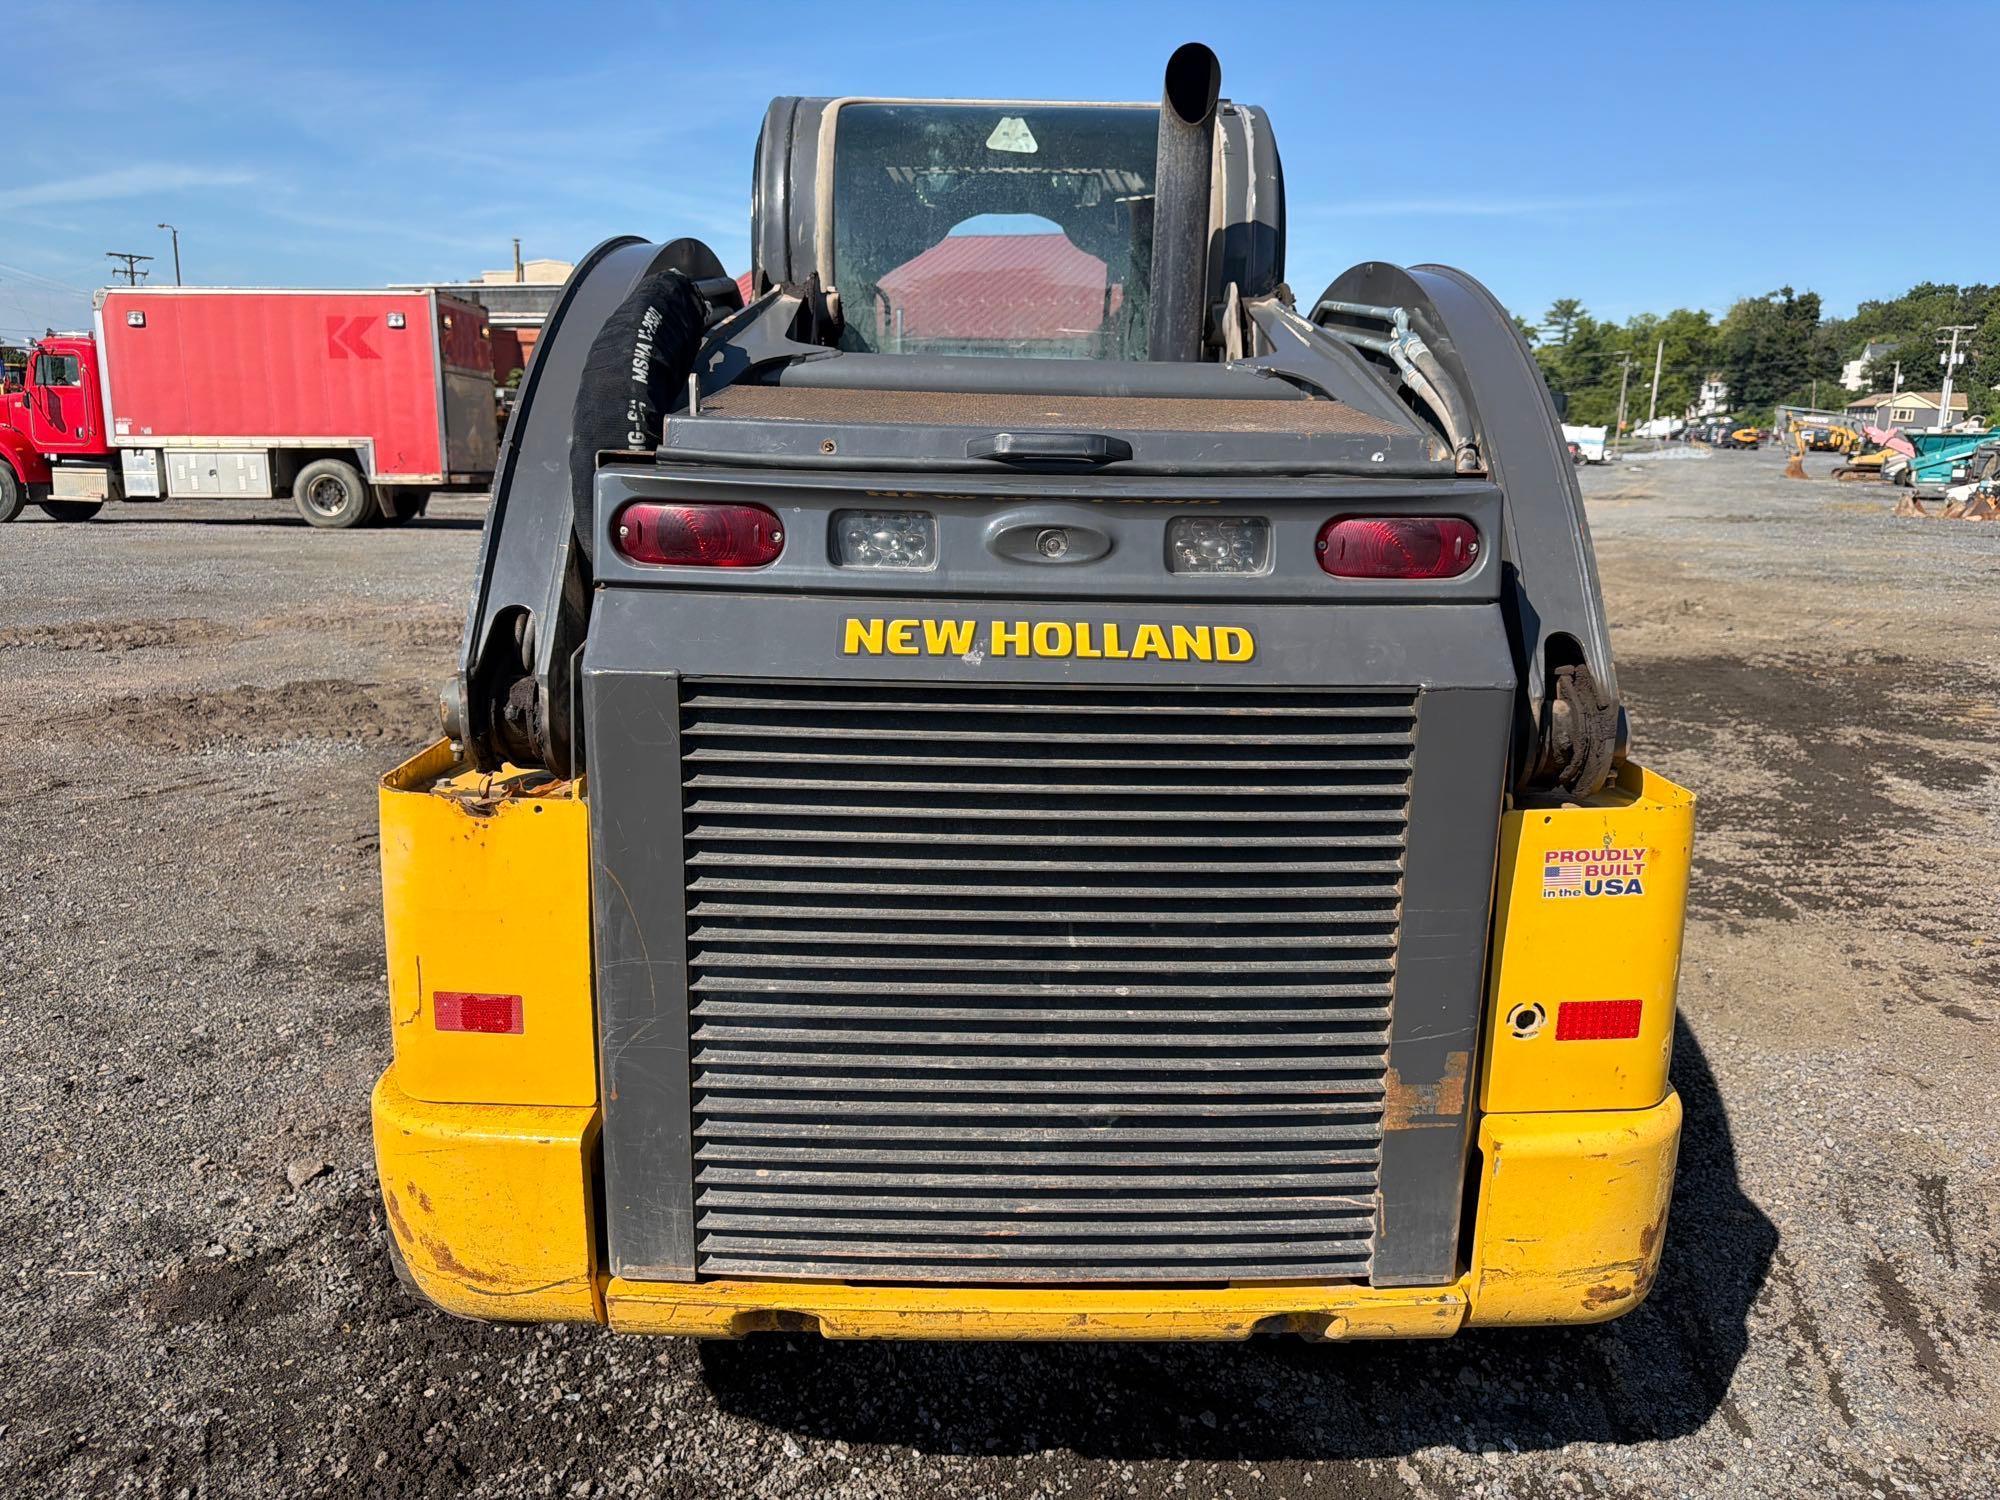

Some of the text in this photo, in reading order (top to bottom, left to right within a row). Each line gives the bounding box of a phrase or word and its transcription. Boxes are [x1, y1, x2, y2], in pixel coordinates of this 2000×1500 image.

[326, 316, 382, 359] K
[632, 343, 653, 385] MSHA
[844, 618, 1256, 662] NEW HOLLAND
[1545, 849, 1645, 863] PROUDLY
[1585, 864, 1645, 877] BUILT
[1543, 879, 1642, 897] in the USA
